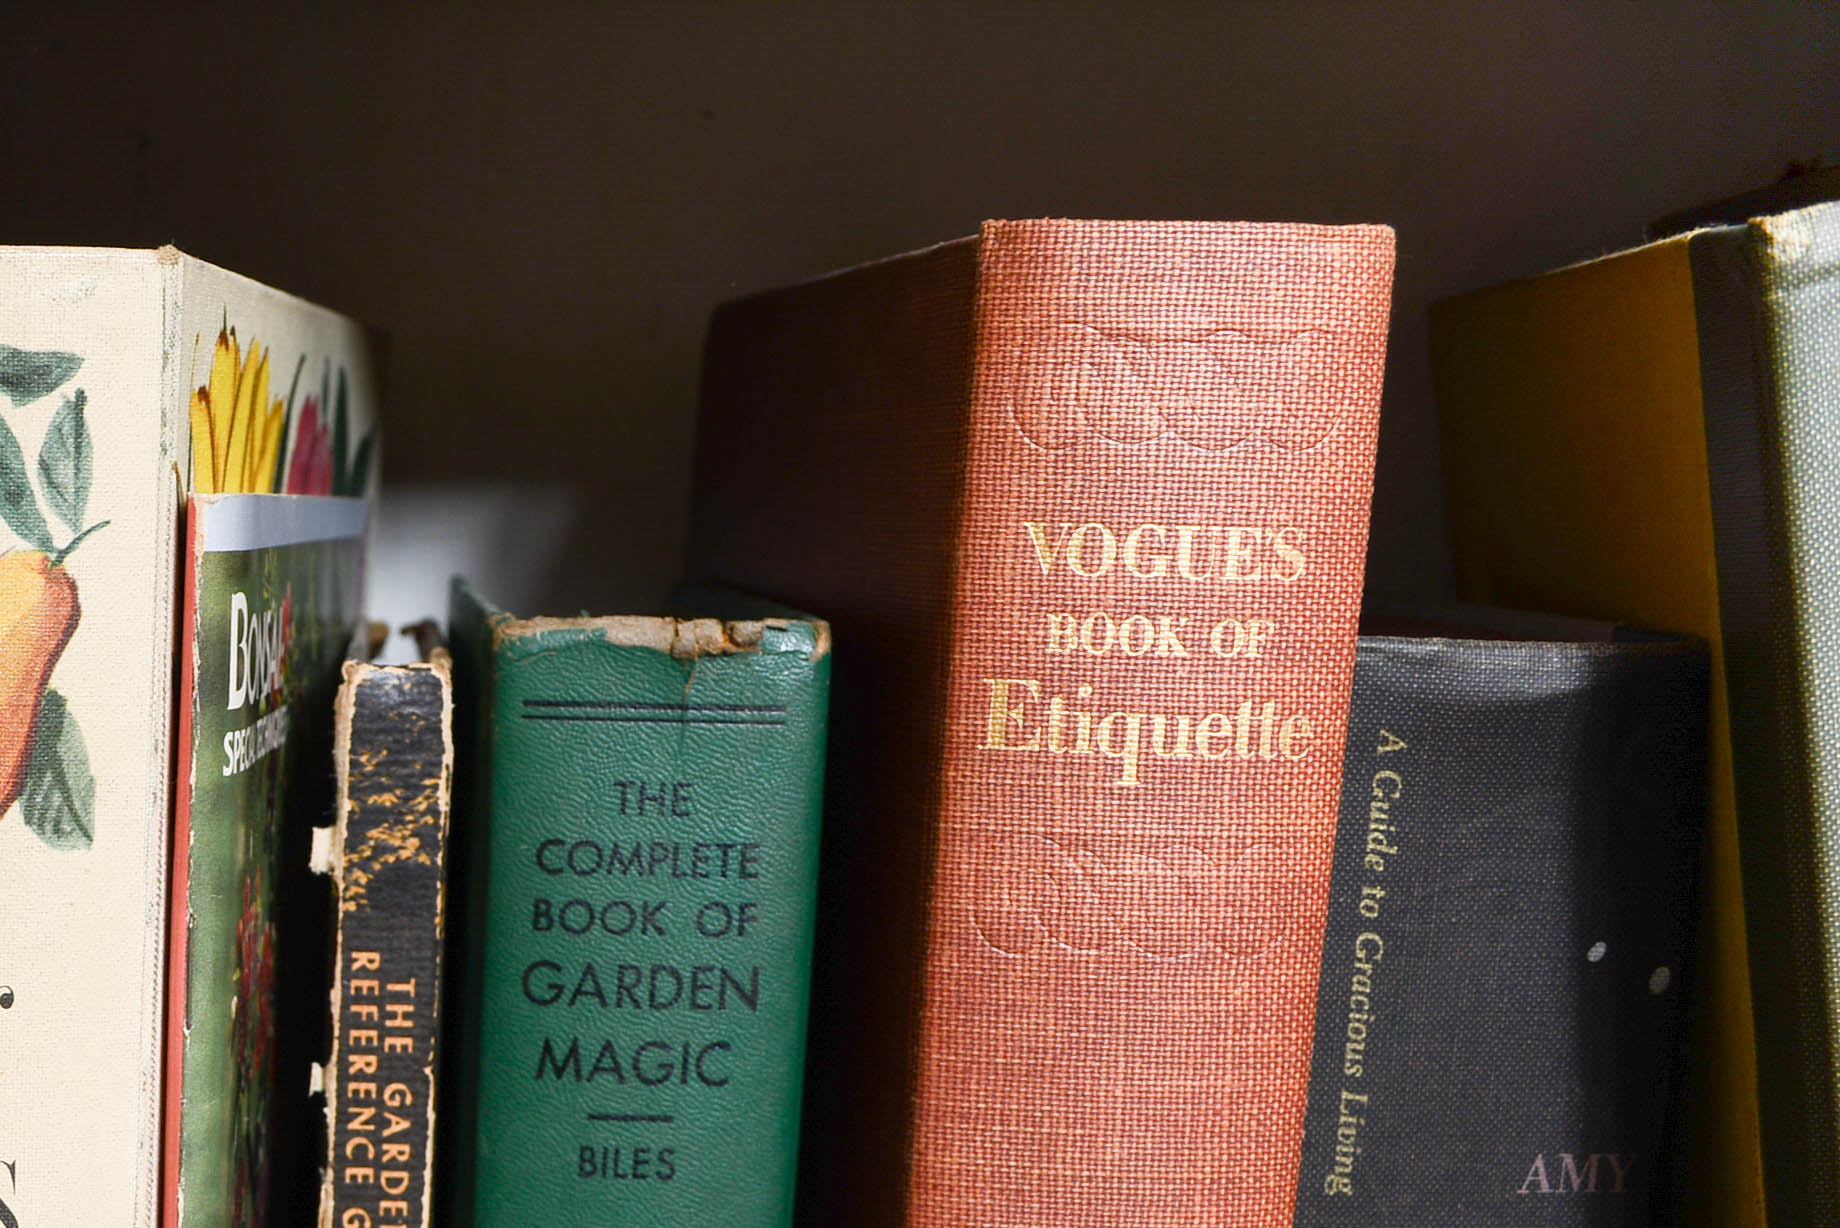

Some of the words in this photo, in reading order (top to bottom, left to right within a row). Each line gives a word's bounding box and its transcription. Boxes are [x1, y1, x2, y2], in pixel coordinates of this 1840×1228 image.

[1023, 521, 1307, 582] VOGUE'S
[1045, 611, 1190, 658] BOOK
[1209, 618, 1275, 658] OF
[977, 678, 1315, 786] Etiquette
[1377, 729, 1408, 755] A
[613, 781, 694, 817] THE
[1363, 769, 1403, 873] Guide
[536, 838, 759, 879] COMPLETE
[532, 899, 667, 935] BOOK
[697, 901, 759, 937] OF
[1360, 885, 1385, 918] to
[521, 961, 759, 1012] GARDEN
[1344, 932, 1384, 1078] Gracious
[384, 977, 416, 1054] THE
[345, 950, 381, 1185] REFERENCE
[534, 1037, 733, 1087] MAGIC
[577, 1146, 677, 1182] BILES
[1324, 1090, 1368, 1197] Living
[1517, 1152, 1638, 1194] AMY
